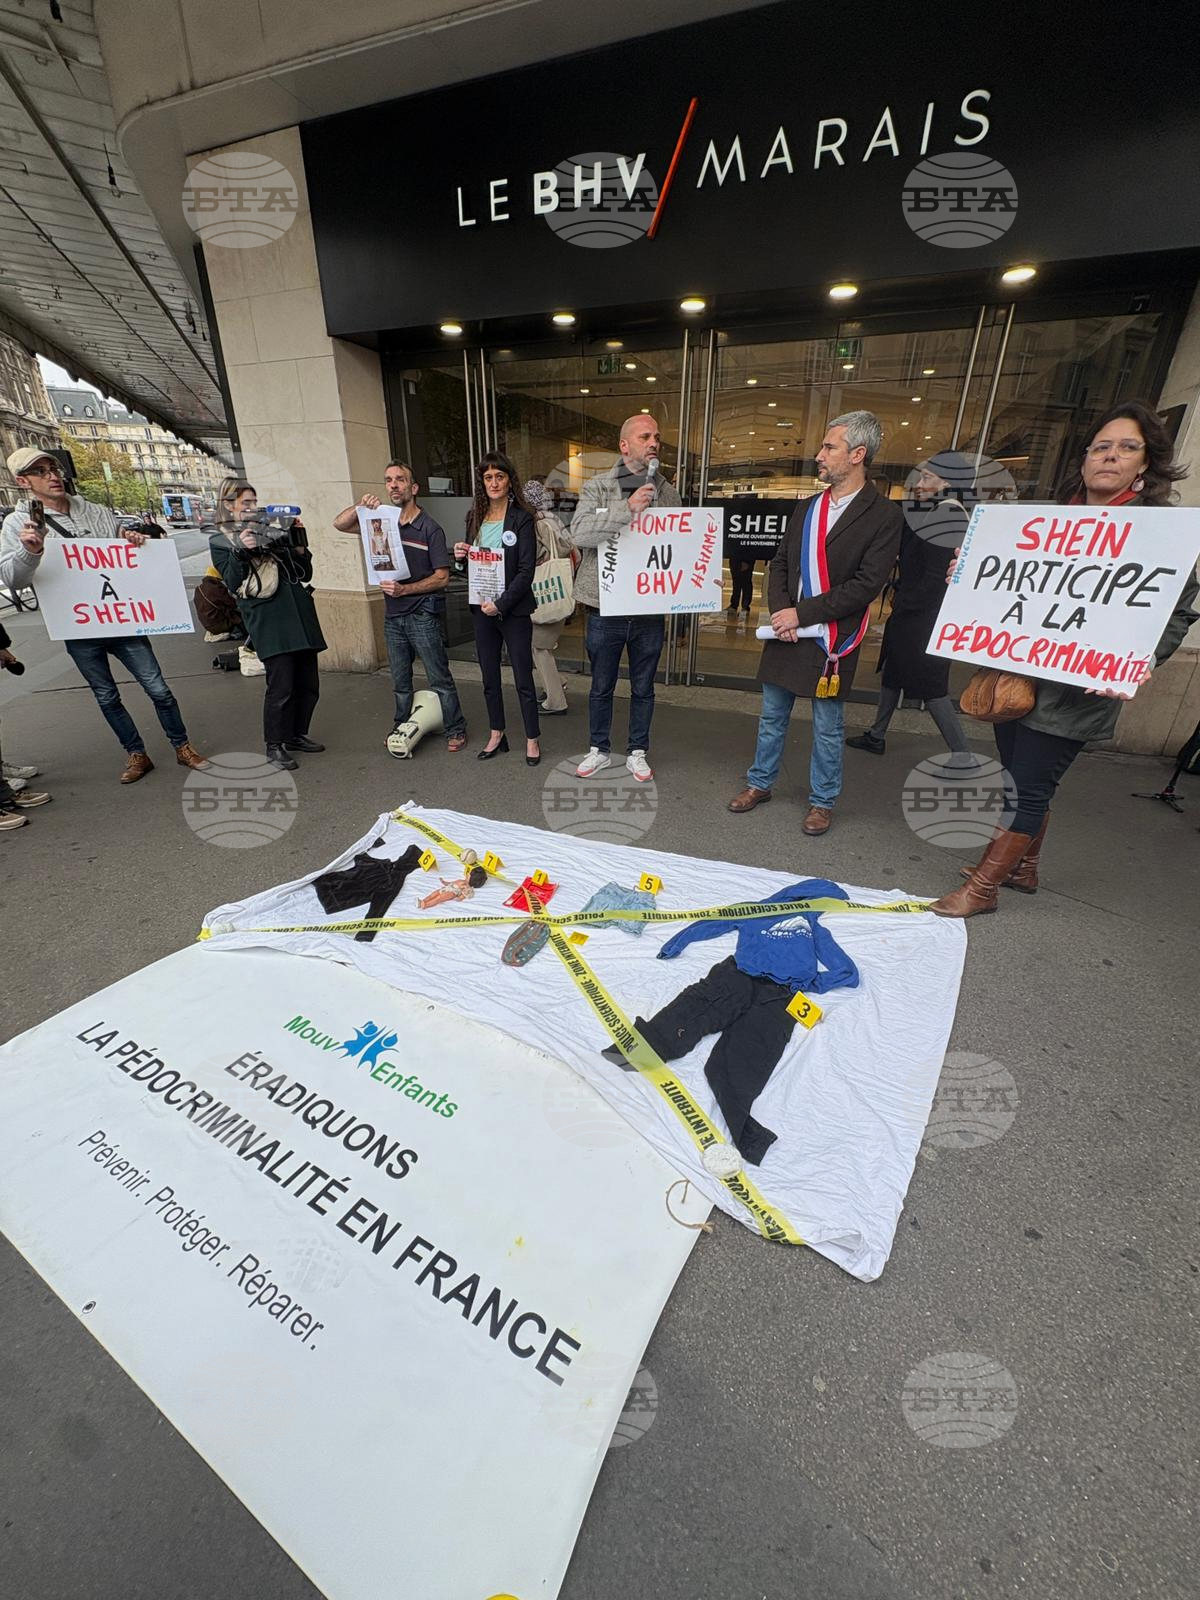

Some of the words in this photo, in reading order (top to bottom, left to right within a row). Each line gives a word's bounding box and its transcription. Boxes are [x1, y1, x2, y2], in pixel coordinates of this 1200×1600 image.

[457, 178, 510, 227] LE
[533, 152, 647, 216] BHV
[696, 88, 992, 189] MARAIS
[630, 511, 692, 536] HONTE
[728, 514, 788, 533] SHEI
[61, 543, 139, 572] HONTE
[469, 551, 503, 562] SHEIN
[646, 543, 673, 570] AU
[99, 573, 119, 601] À
[636, 569, 684, 595] BHV
[1000, 593, 1028, 625] À
[1041, 603, 1087, 632] LA
[935, 619, 1150, 685] PÉDOCRIMINALITÉ
[422, 854, 431, 866] 6
[488, 855, 494, 867] 7
[537, 872, 543, 883] 1
[644, 877, 654, 890] 5
[573, 912, 604, 922] POLICE
[641, 911, 688, 920] INTERDITE
[689, 910, 712, 918] ZONE
[718, 903, 778, 917] SCIENTIFIQUE
[778, 902, 810, 910] POLICE
[364, 920, 397, 929] POLICE
[568, 956, 587, 977] ZONE
[580, 978, 621, 1029] SCIENTIFIQUE
[796, 1002, 811, 1018] 3
[282, 1015, 341, 1051] Mouv
[369, 1061, 459, 1119] Enfants
[223, 1050, 419, 1180] ÉRADIQUONS
[660, 1080, 710, 1135] INTERDITE
[75, 1020, 120, 1052] LA
[104, 1039, 352, 1217] PÉDOCRIMINALITÉ
[335, 1197, 403, 1256] EN
[391, 1234, 582, 1387] FRANCE
[77, 1129, 151, 1198] Prévenir.
[144, 1185, 231, 1268] Protéger.
[227, 1253, 325, 1351] Réparer.
